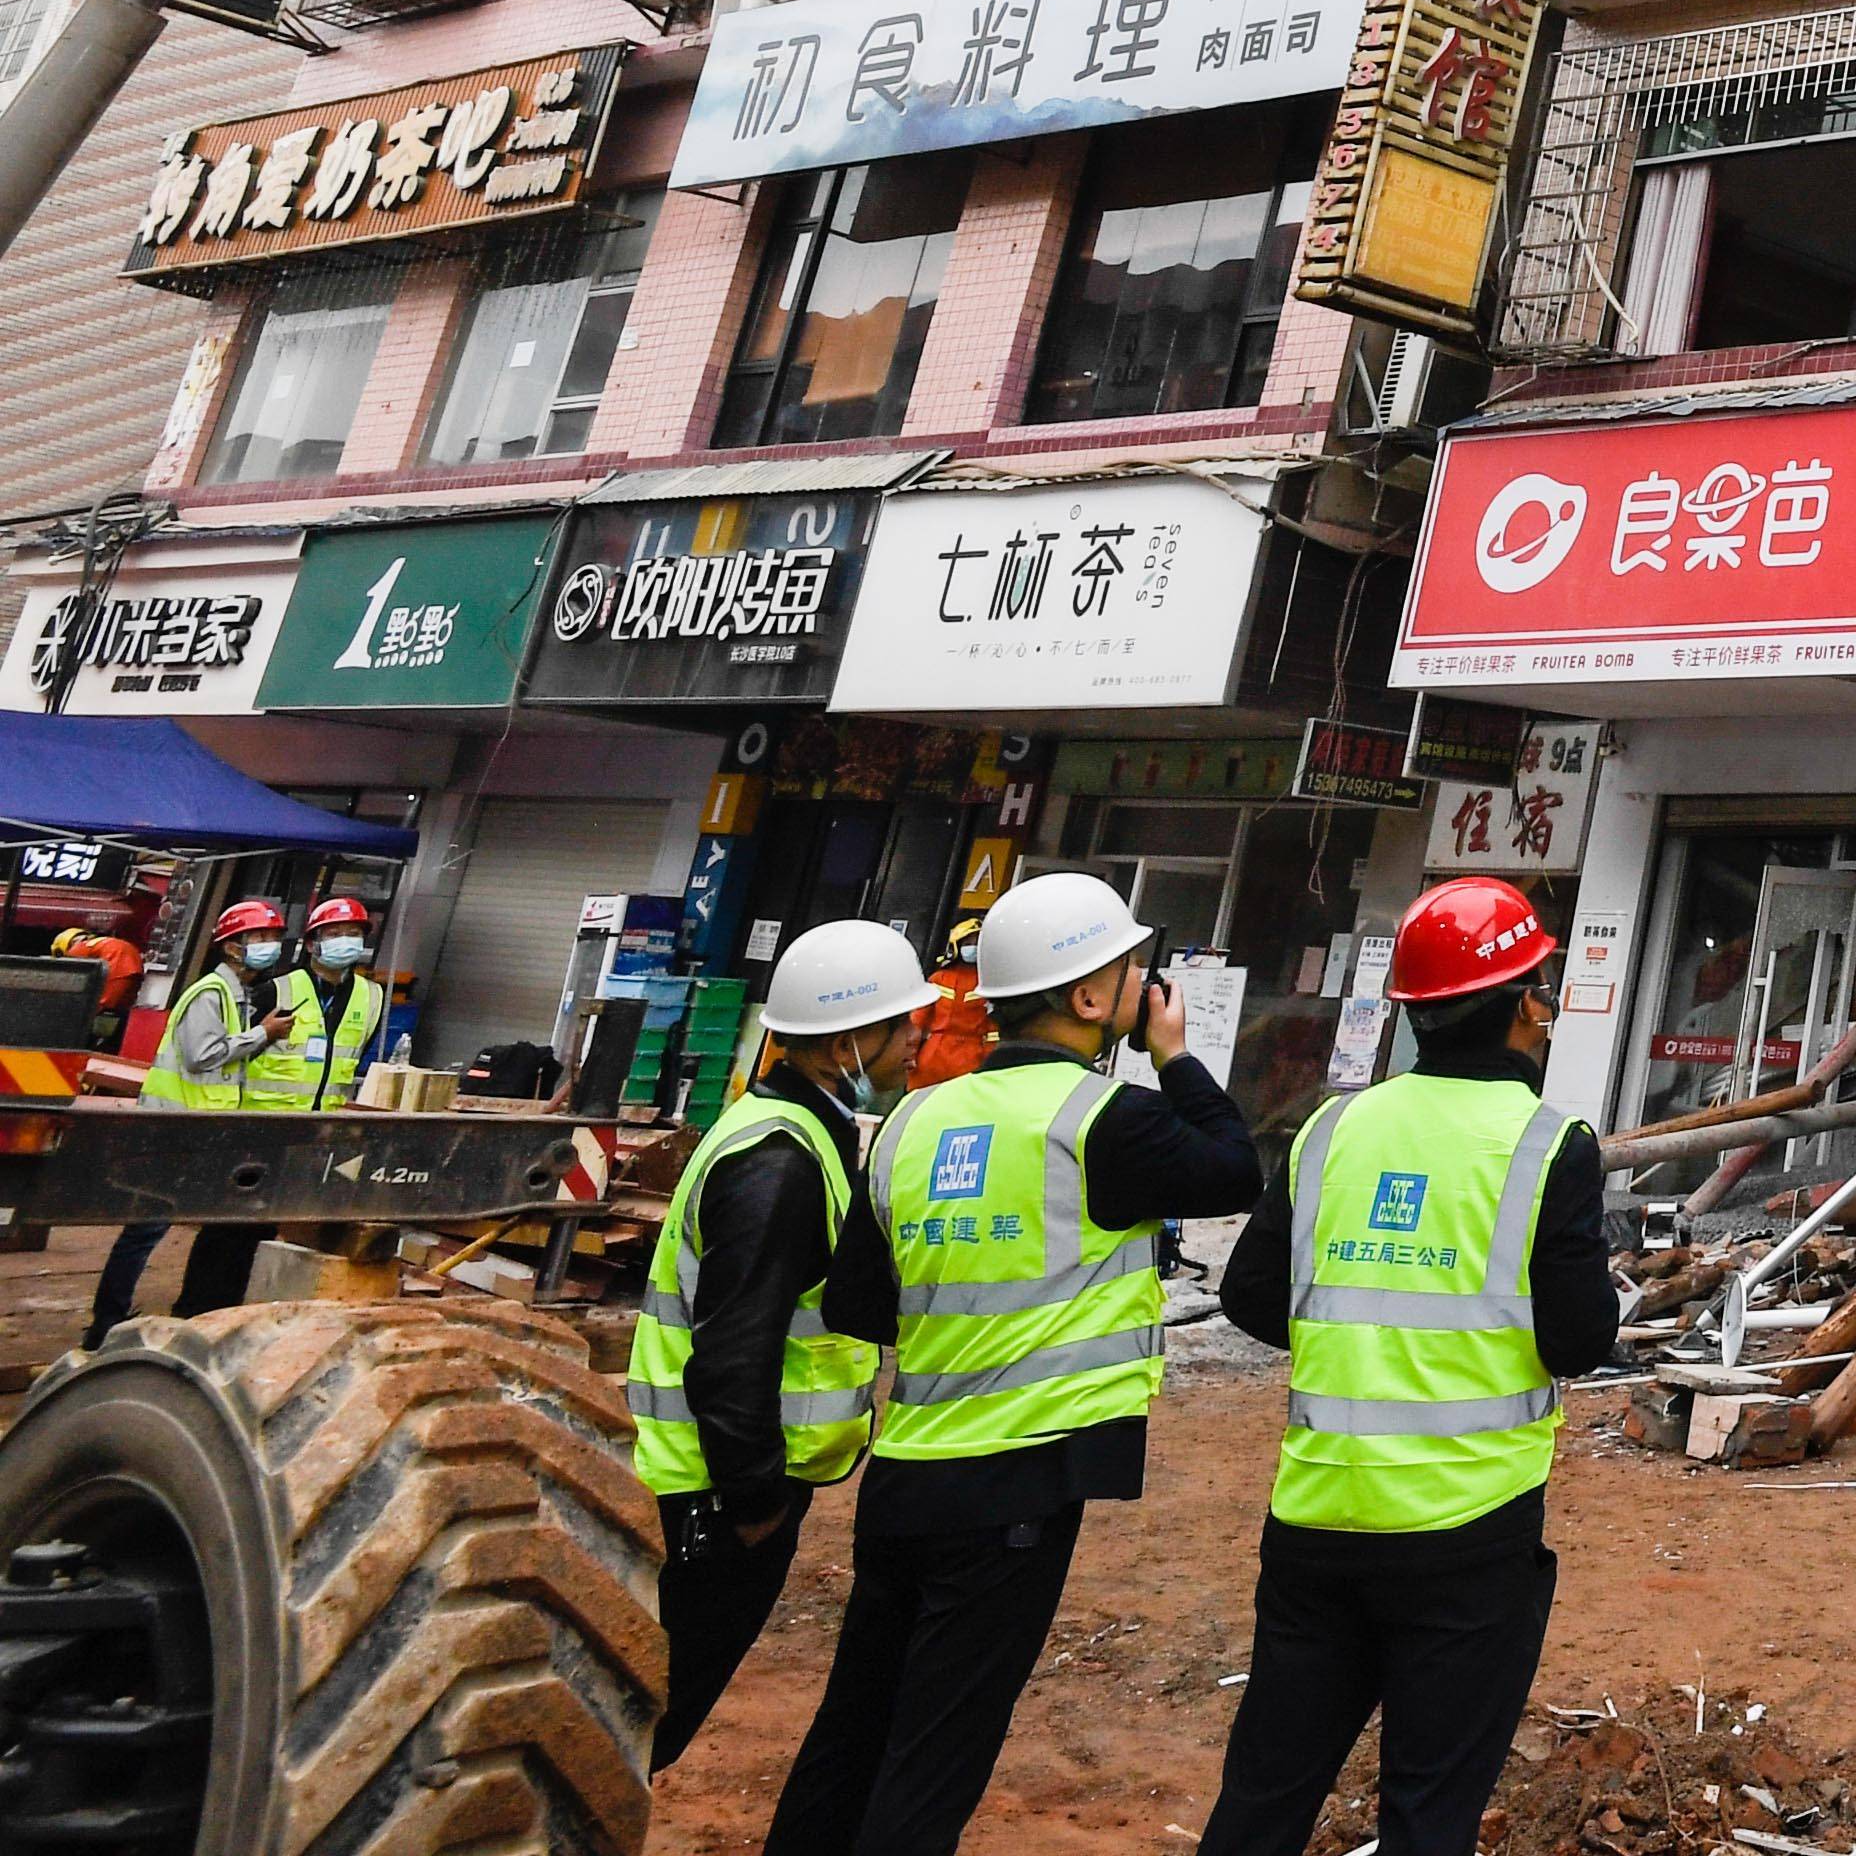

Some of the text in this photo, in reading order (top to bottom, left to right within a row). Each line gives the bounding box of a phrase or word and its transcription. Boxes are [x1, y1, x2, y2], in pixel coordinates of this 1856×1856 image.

[936, 522, 1136, 623] 七杯茶
[1415, 652, 1635, 676] 专注平价鲜果茶 FRUITEA BOMB
[1671, 644, 1783, 667] 专注平价鲜果茶
[1795, 644, 1856, 661] FRUITEA
[1451, 784, 1564, 860] 住宿
[369, 1166, 430, 1185] 4.2m
[1327, 1237, 1458, 1270] 中建五局三公司
